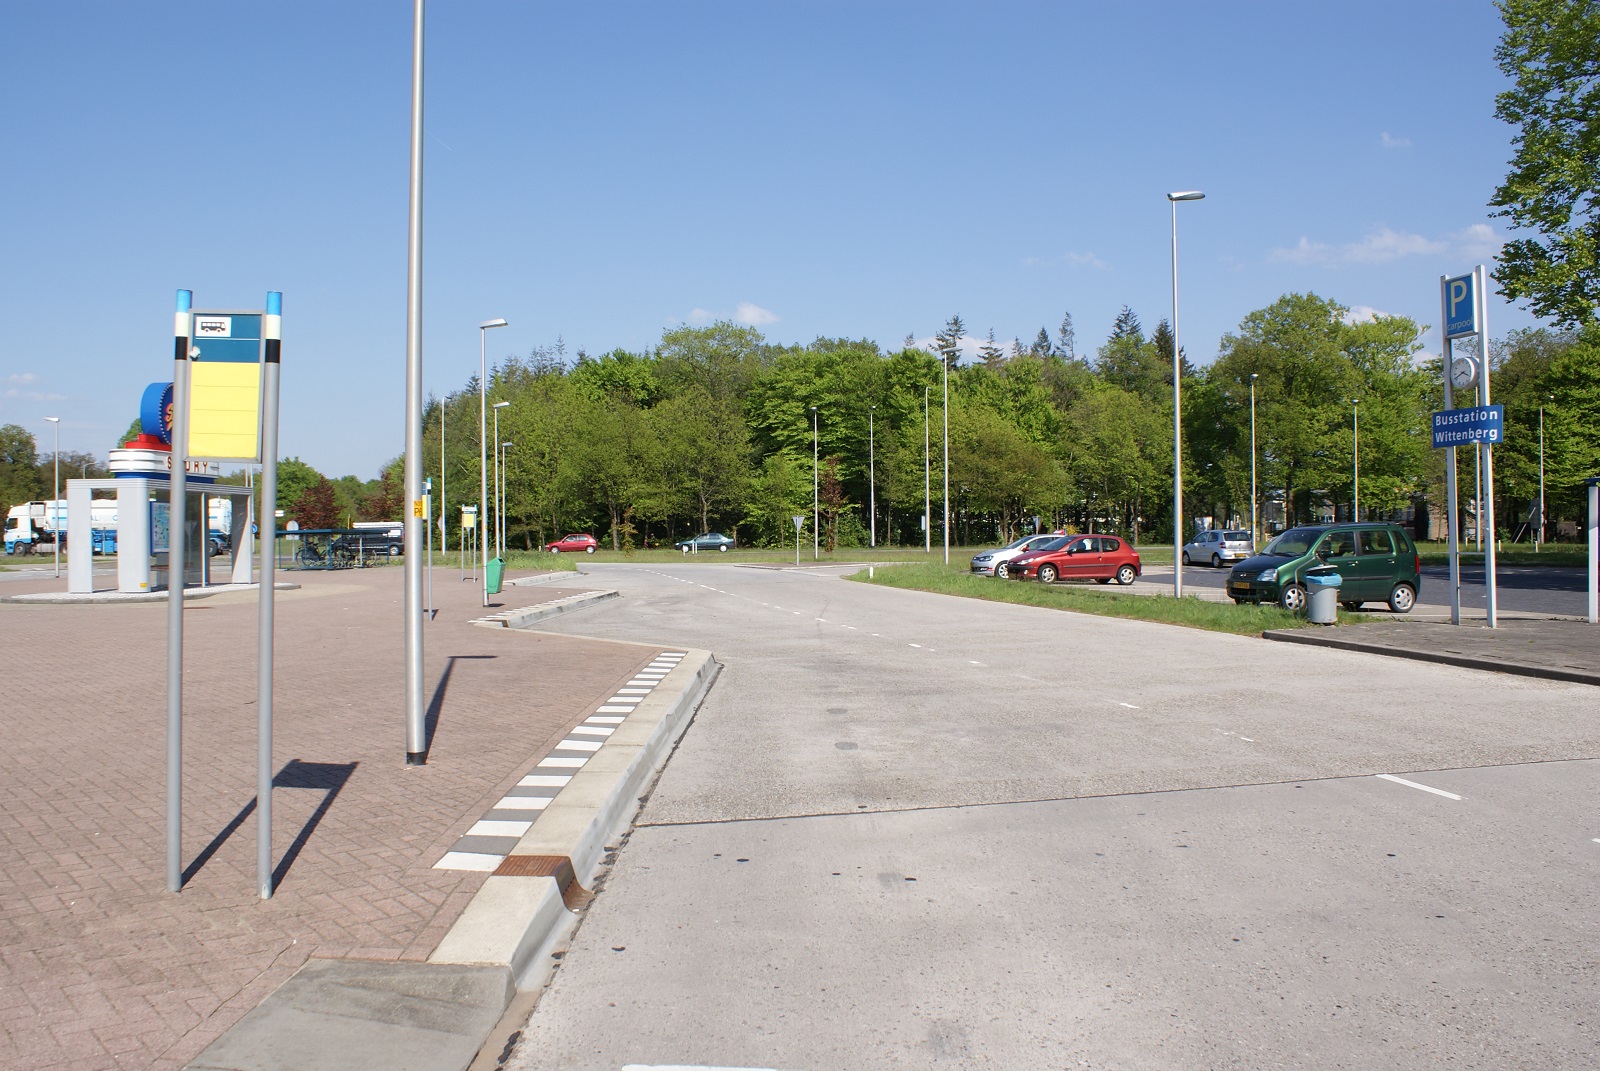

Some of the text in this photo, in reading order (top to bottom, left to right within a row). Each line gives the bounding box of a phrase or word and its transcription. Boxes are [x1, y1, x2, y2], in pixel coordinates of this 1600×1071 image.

[1450, 280, 1468, 318] P
[1435, 409, 1498, 427] Busstation
[1435, 428, 1498, 442] Wittenberg
